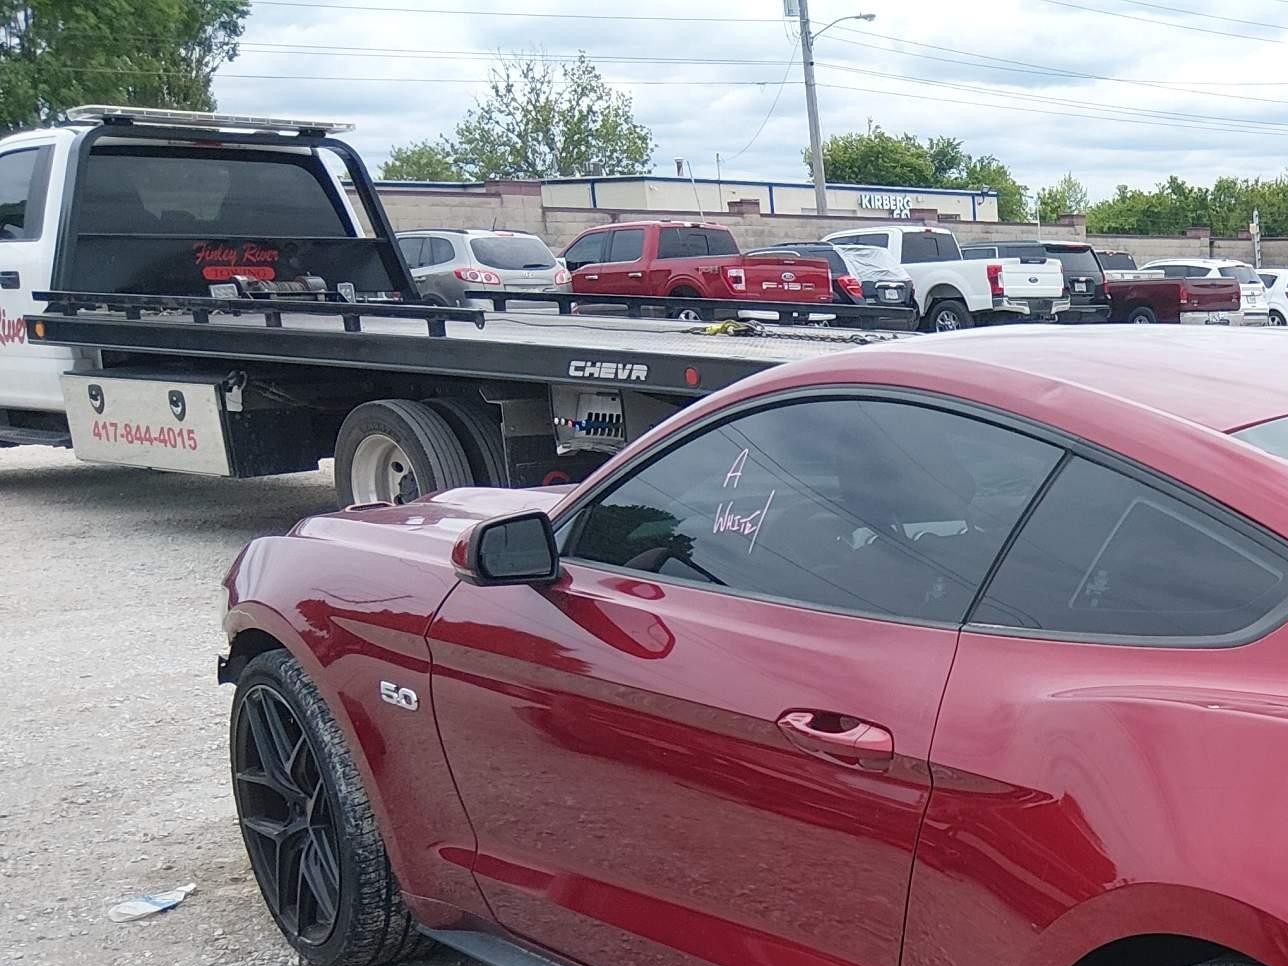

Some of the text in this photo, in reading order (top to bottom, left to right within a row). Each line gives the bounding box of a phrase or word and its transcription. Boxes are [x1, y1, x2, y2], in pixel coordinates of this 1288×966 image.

[193, 241, 279, 266] Finley River
[568, 360, 648, 381] CHEVR
[92, 420, 198, 451] 417-844-4015
[722, 448, 749, 489] A
